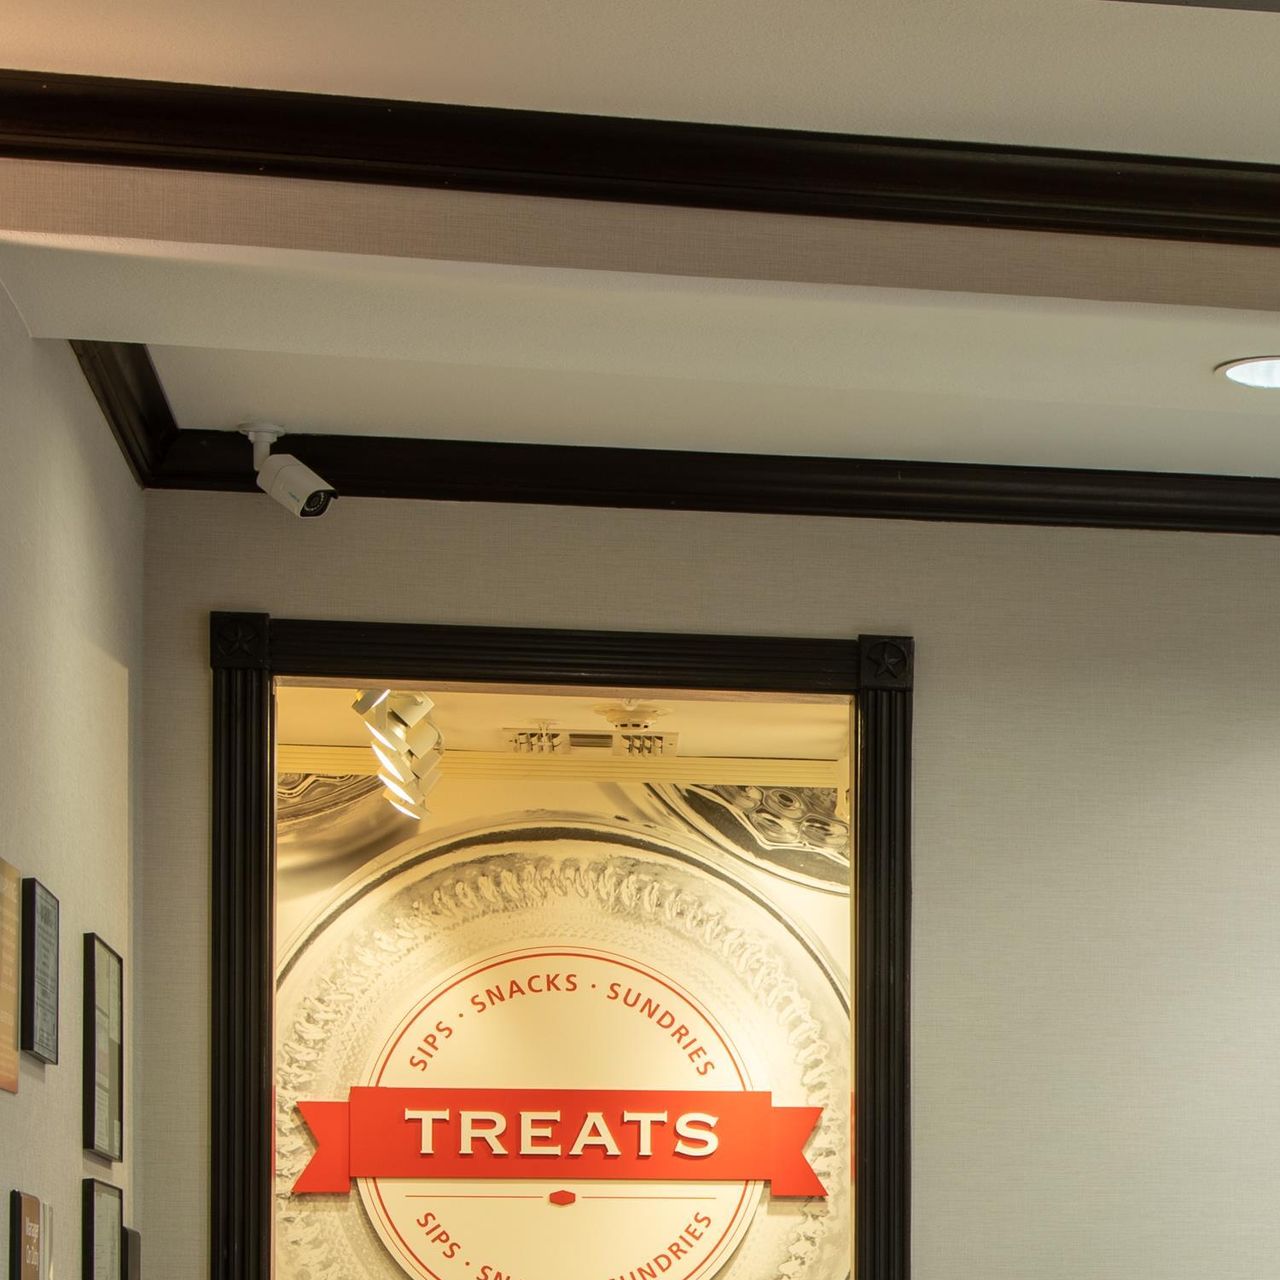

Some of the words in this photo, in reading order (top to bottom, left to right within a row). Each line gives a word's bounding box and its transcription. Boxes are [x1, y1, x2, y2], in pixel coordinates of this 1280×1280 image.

[409, 1020, 453, 1072] SIPS
[470, 973, 578, 1013] SNACKS
[606, 982, 715, 1076] SUNDRIES
[404, 1107, 720, 1157] TREATS
[416, 1211, 461, 1259] SIPS
